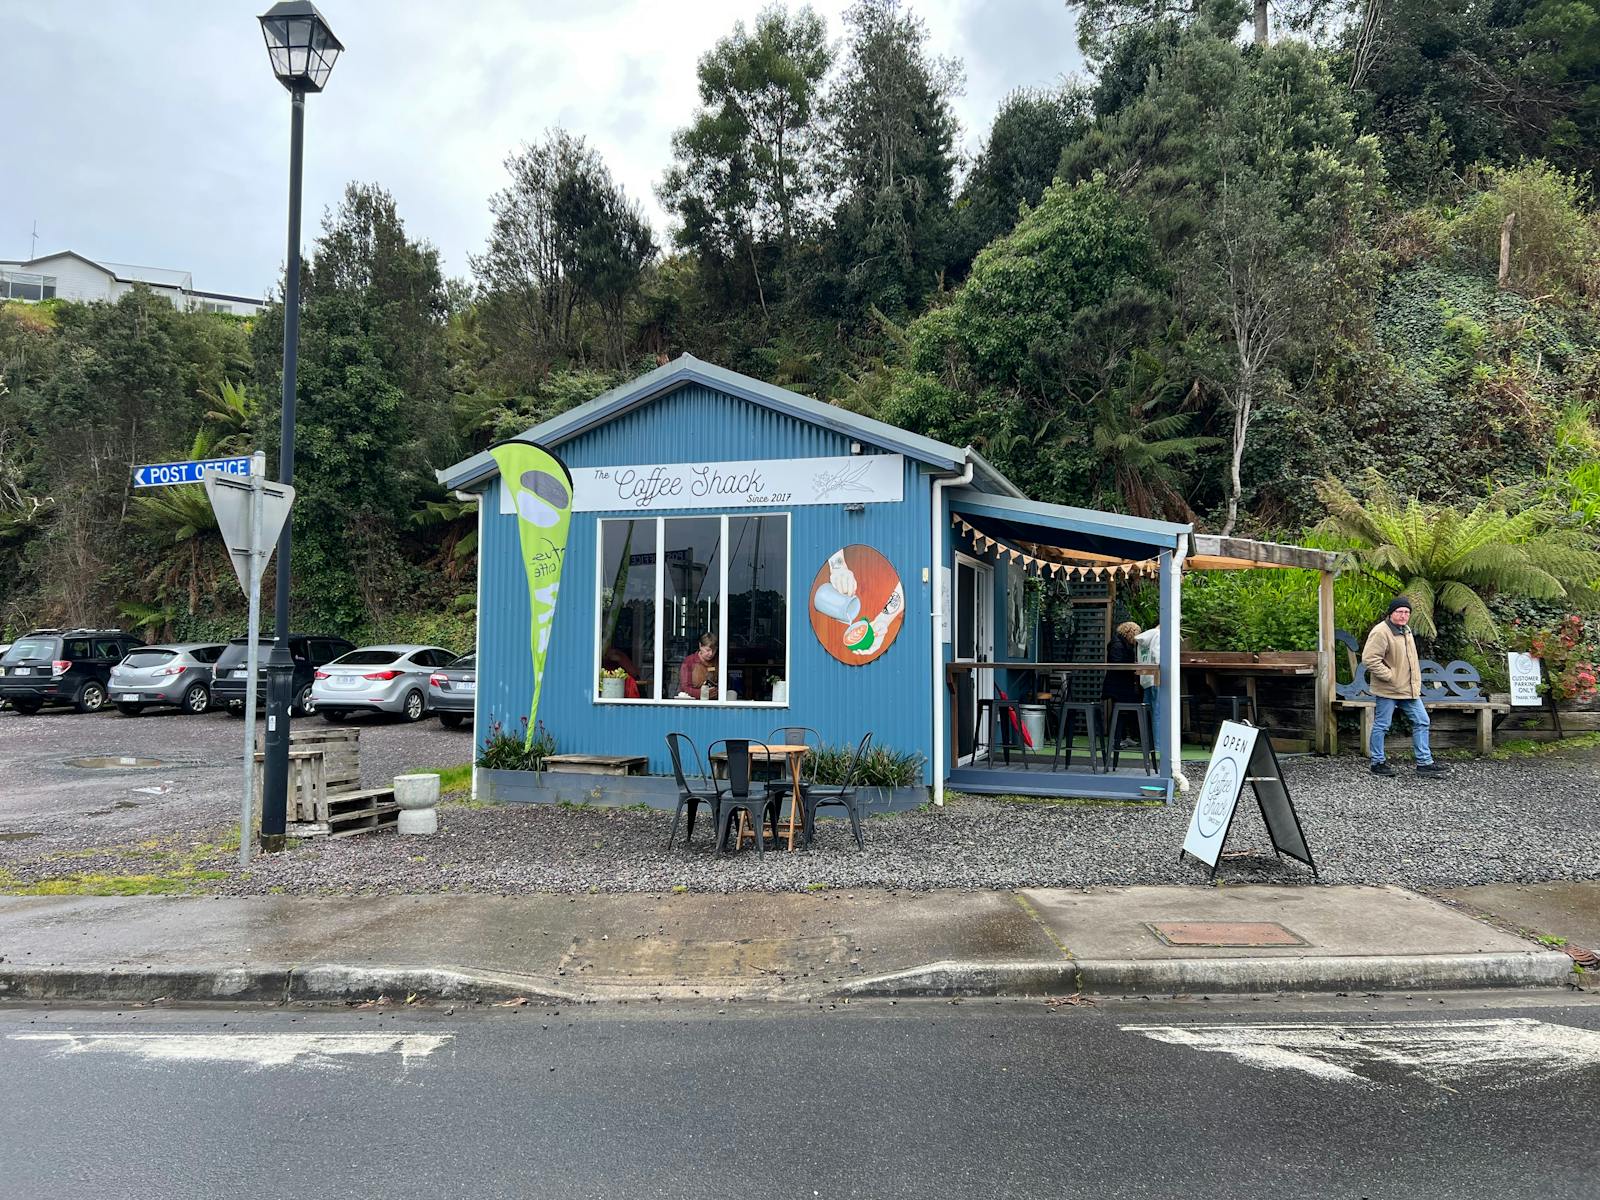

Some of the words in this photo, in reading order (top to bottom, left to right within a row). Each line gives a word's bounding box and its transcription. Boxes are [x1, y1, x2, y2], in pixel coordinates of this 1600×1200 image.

[150, 465, 188, 483] POST
[594, 469, 609, 479] The
[614, 467, 683, 507] Coffee
[691, 466, 765, 497] Shack
[746, 494, 769, 503] Since
[770, 493, 792, 503] 2017
[1223, 735, 1249, 754] OPEN
